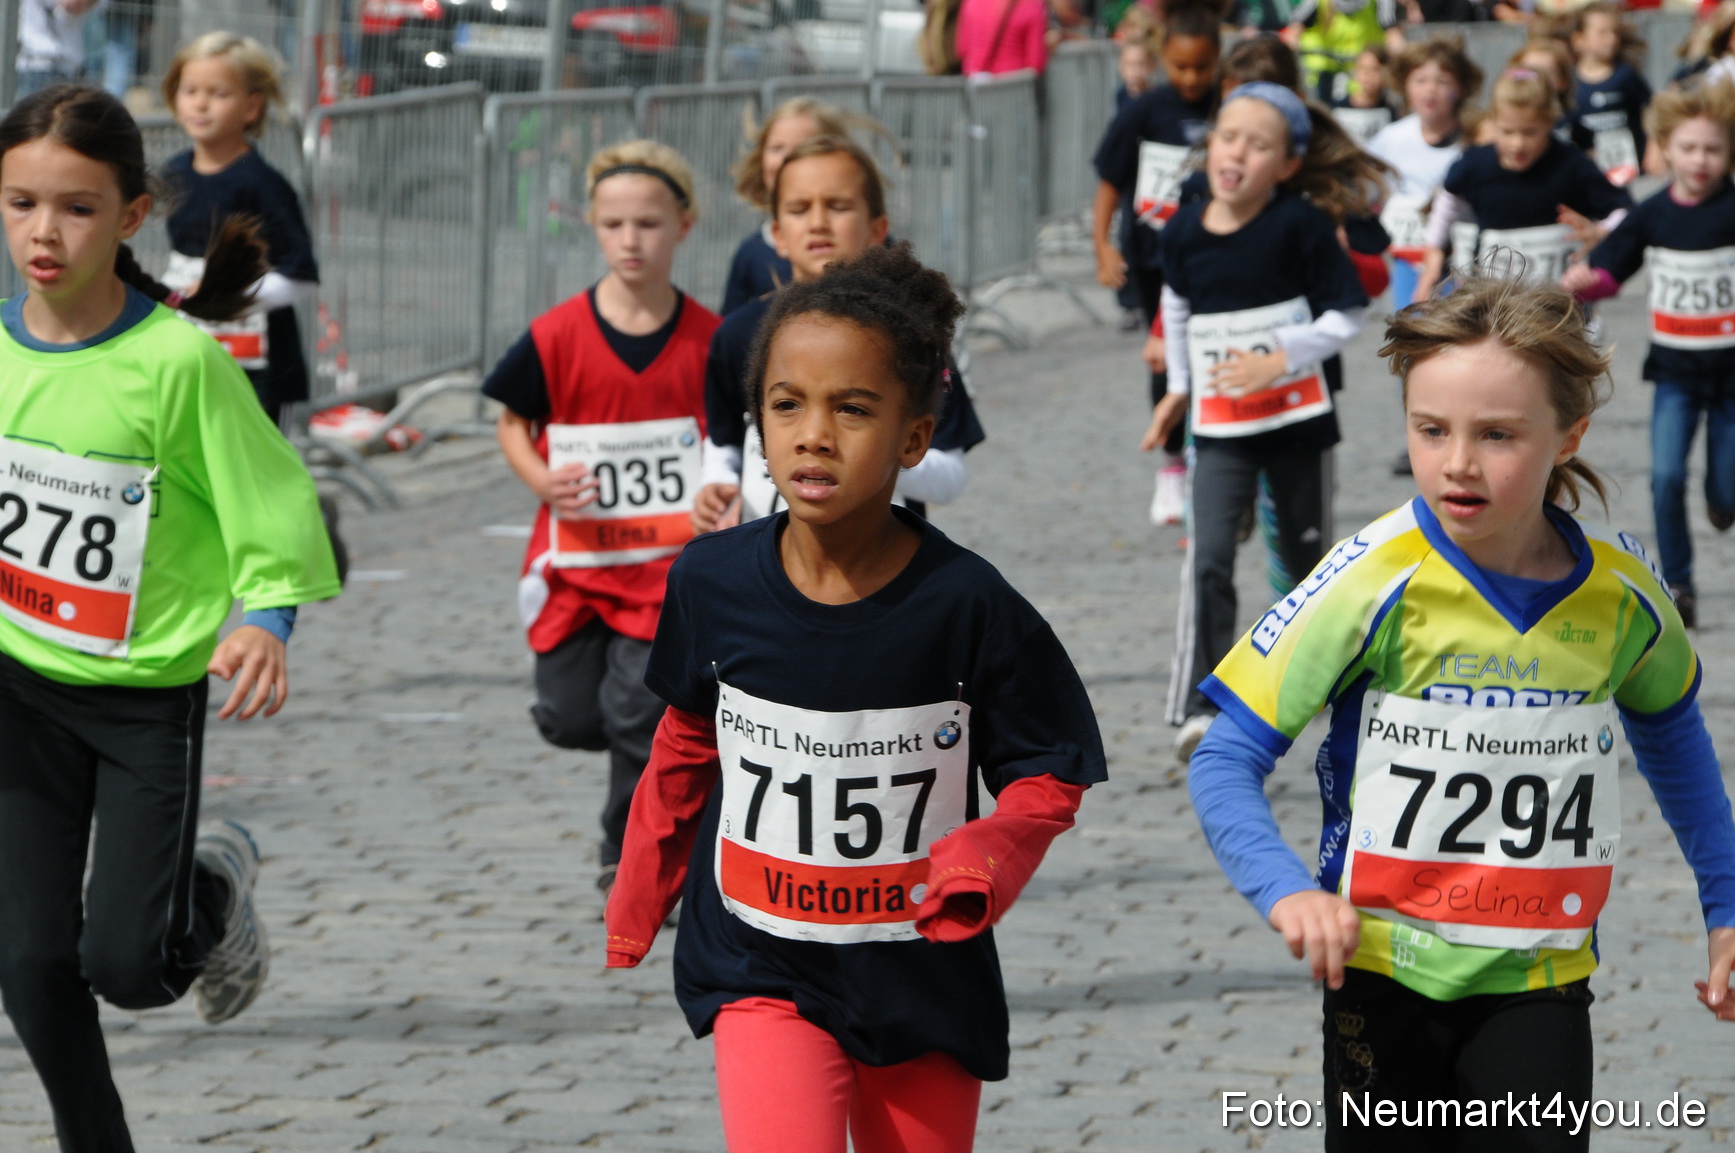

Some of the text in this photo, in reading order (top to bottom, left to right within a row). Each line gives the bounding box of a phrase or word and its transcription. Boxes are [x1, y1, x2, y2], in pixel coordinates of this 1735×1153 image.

[1659, 275, 1734, 311] 7258
[9, 461, 111, 500] Neumarkt
[595, 455, 684, 510] 035
[0, 491, 116, 582] 278
[596, 523, 657, 546] Elena
[1, 569, 54, 615] Nina
[1251, 533, 1369, 658] BOCK
[1435, 653, 1539, 682] TEAM
[721, 708, 923, 758] PARTL Neumarkt
[1366, 717, 1589, 756] PARTL Neumarkt
[739, 755, 937, 860] 7157
[1388, 763, 1595, 859] 7294
[764, 866, 905, 913] Victoria
[1404, 867, 1550, 918] Selina
